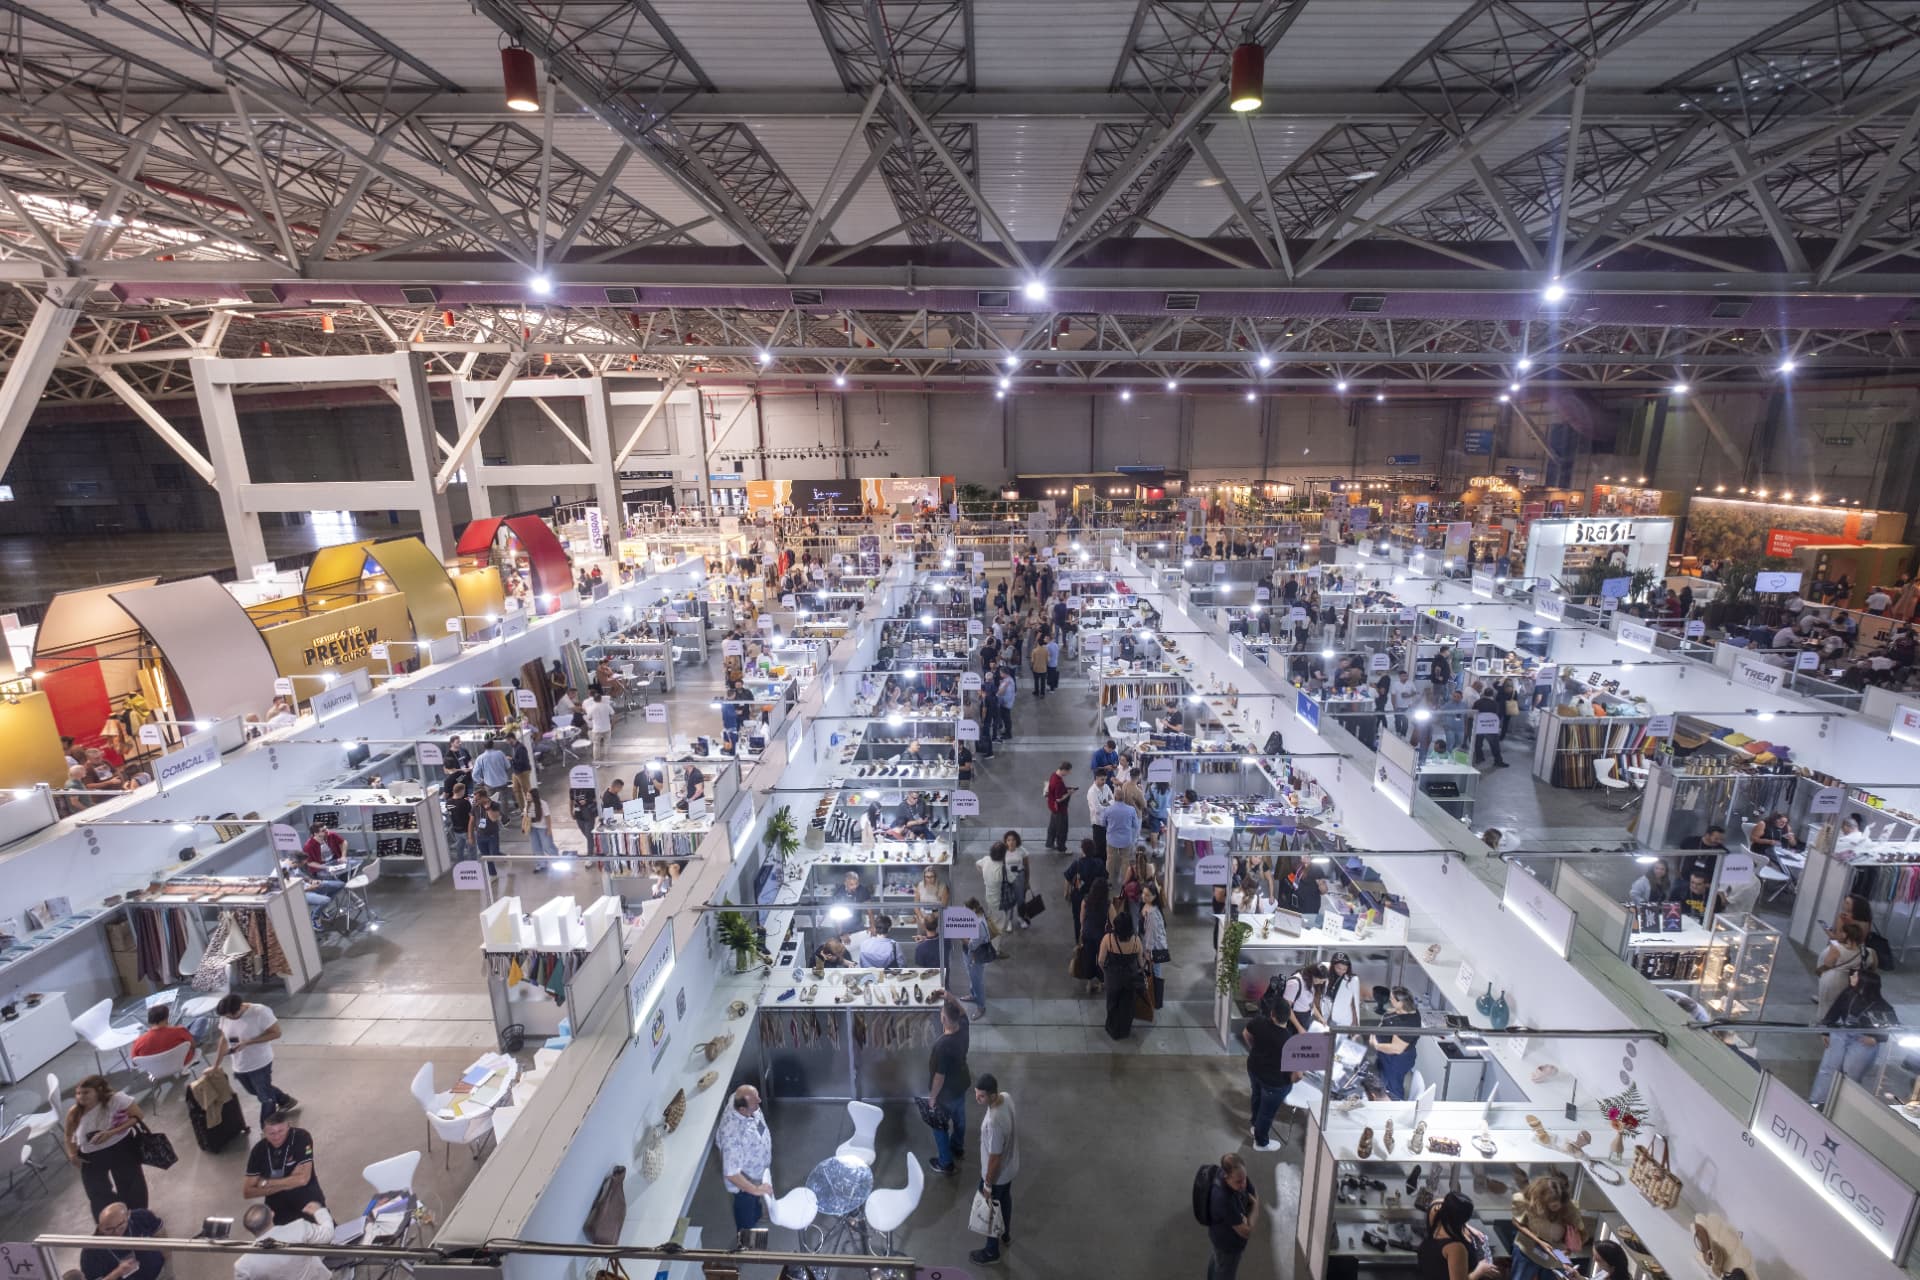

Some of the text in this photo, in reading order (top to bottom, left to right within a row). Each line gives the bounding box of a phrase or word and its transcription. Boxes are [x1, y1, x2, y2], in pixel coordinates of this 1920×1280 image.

[304, 628, 378, 665] PREVIEW
[1744, 667, 1778, 684] TREAT
[162, 755, 205, 779] COMCAL
[1741, 1131, 1755, 1148] 60
